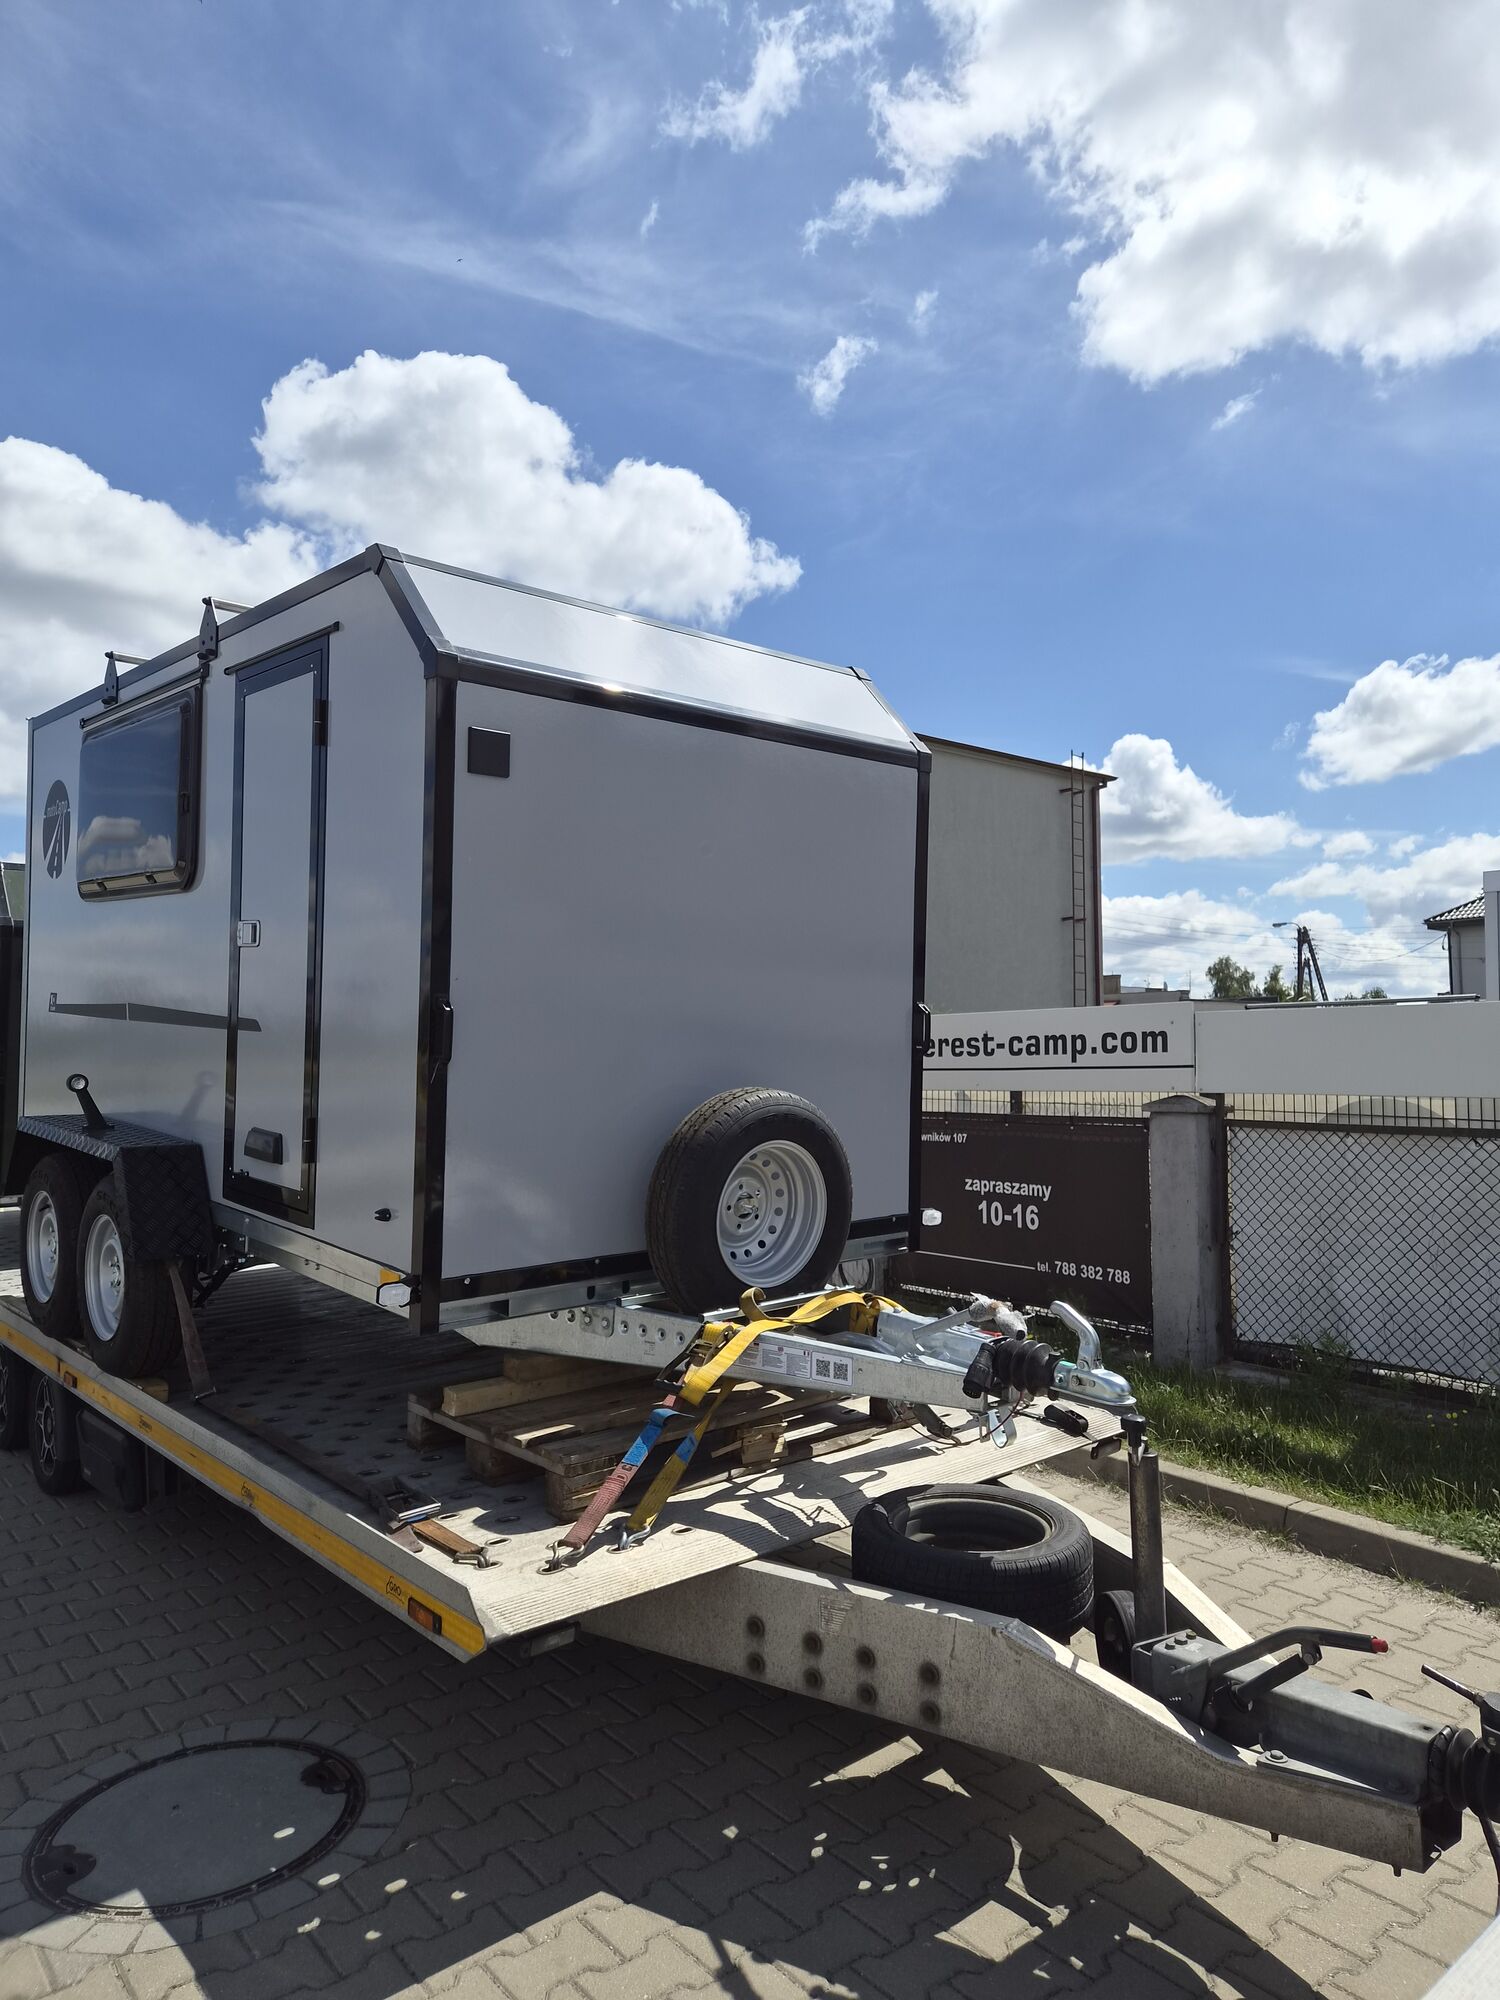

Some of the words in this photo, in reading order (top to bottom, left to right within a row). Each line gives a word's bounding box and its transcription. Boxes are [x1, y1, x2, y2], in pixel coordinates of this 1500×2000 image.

[953, 1133, 967, 1144] 107
[965, 1177, 1052, 1202] zapraszamy
[978, 1199, 1040, 1231] 10-16
[1037, 1261, 1051, 1273] tel.
[1054, 1259, 1077, 1277] 788
[1080, 1263, 1103, 1281] 382
[1107, 1267, 1131, 1285] 788
